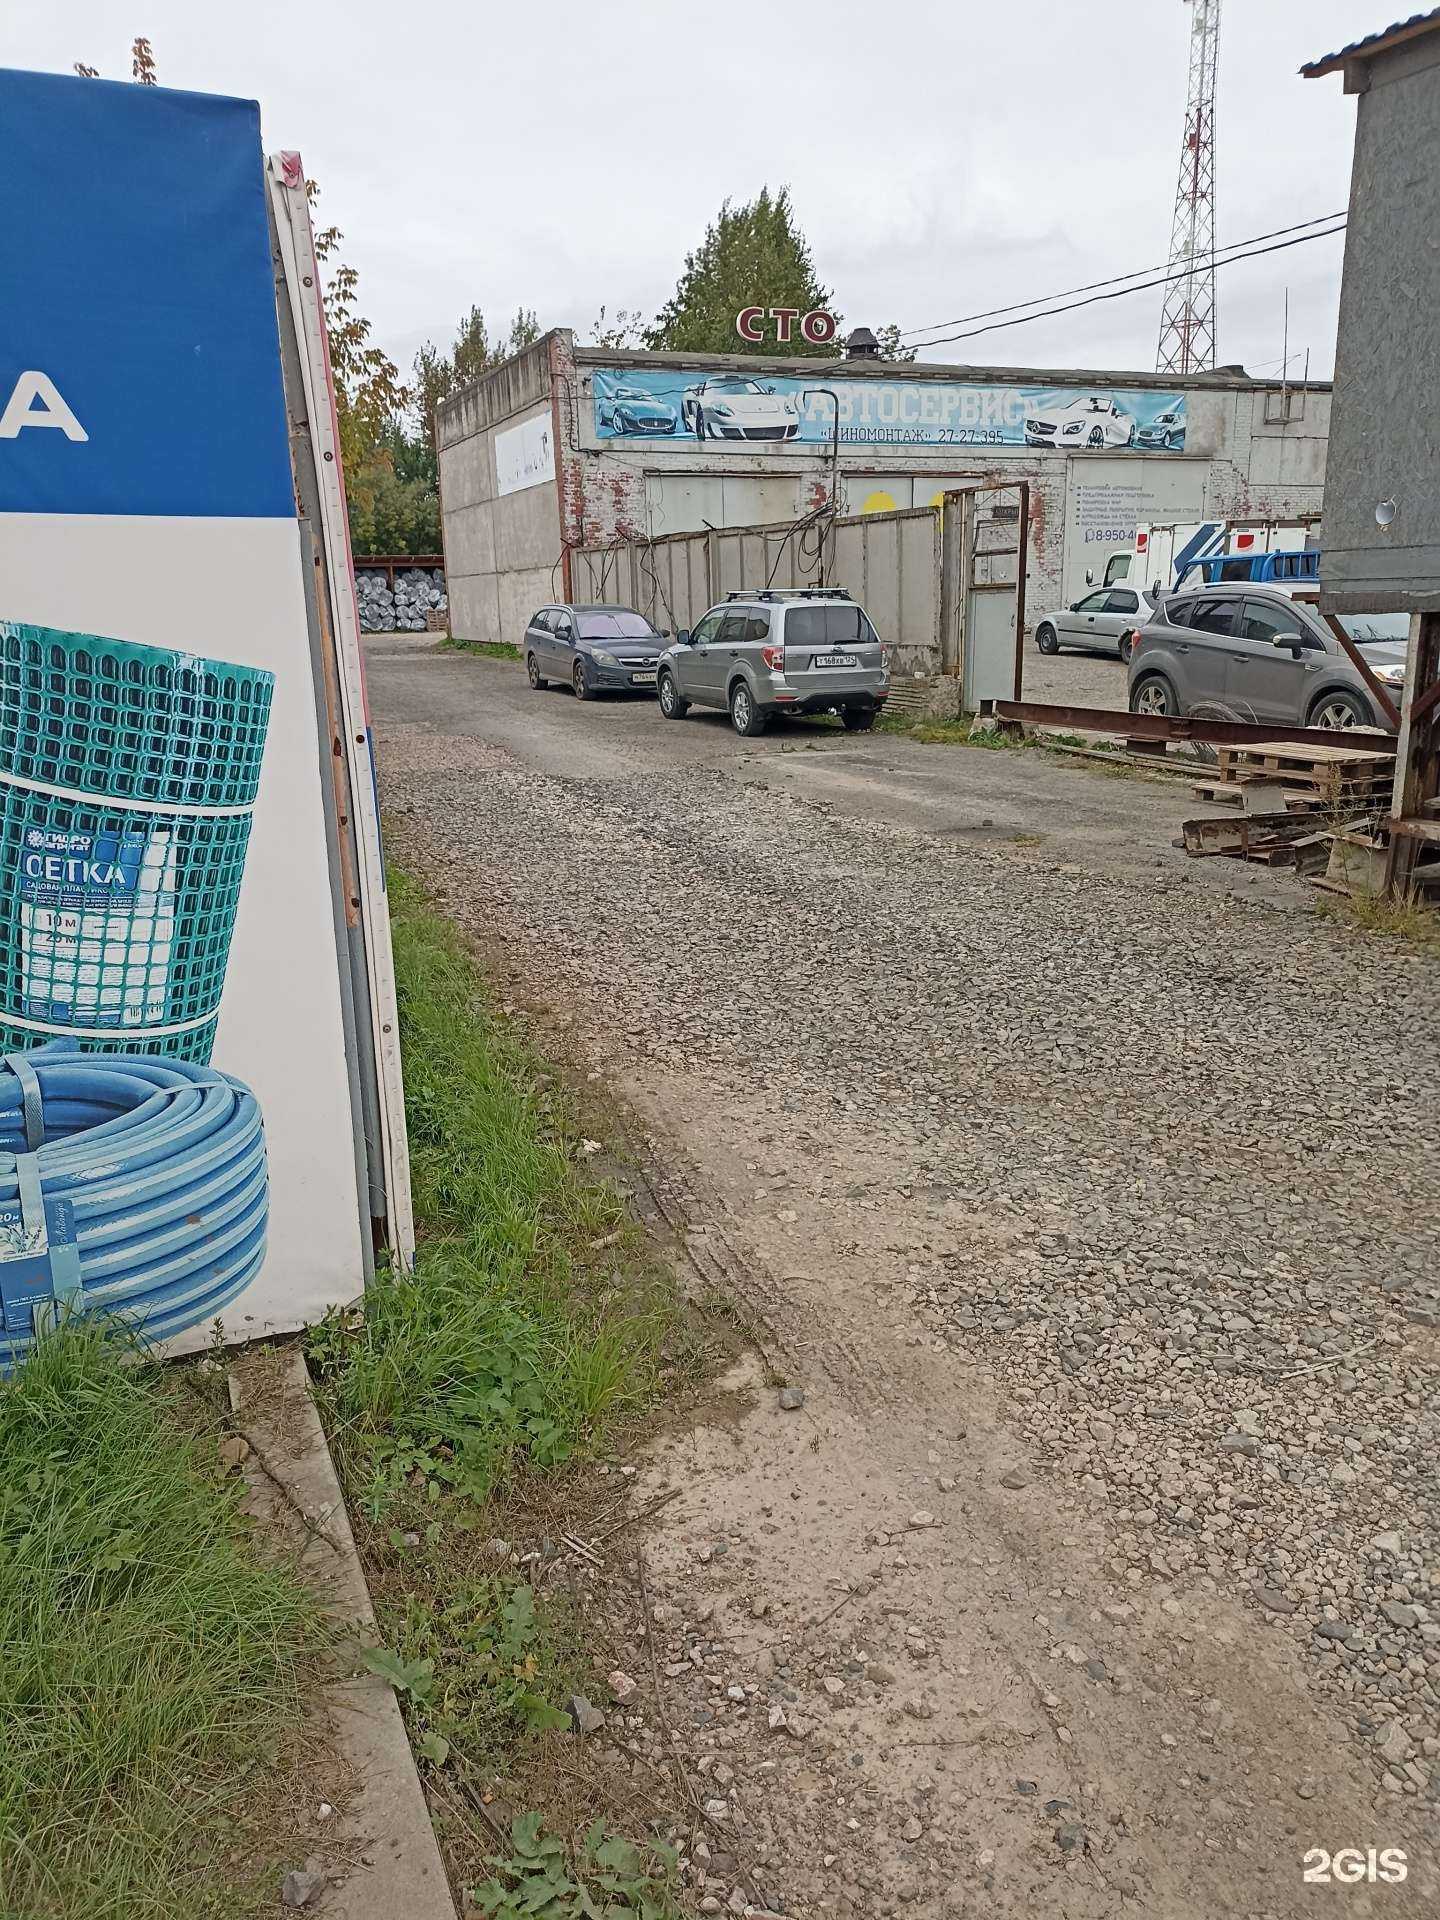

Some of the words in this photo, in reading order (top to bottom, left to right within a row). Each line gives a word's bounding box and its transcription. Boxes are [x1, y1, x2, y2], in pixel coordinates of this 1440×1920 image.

[736, 306, 837, 344] СТО
[938, 430, 1004, 445] 27-27-395
[1095, 529, 1137, 541] 8-950-4
[26, 854, 127, 885] СЕТКА
